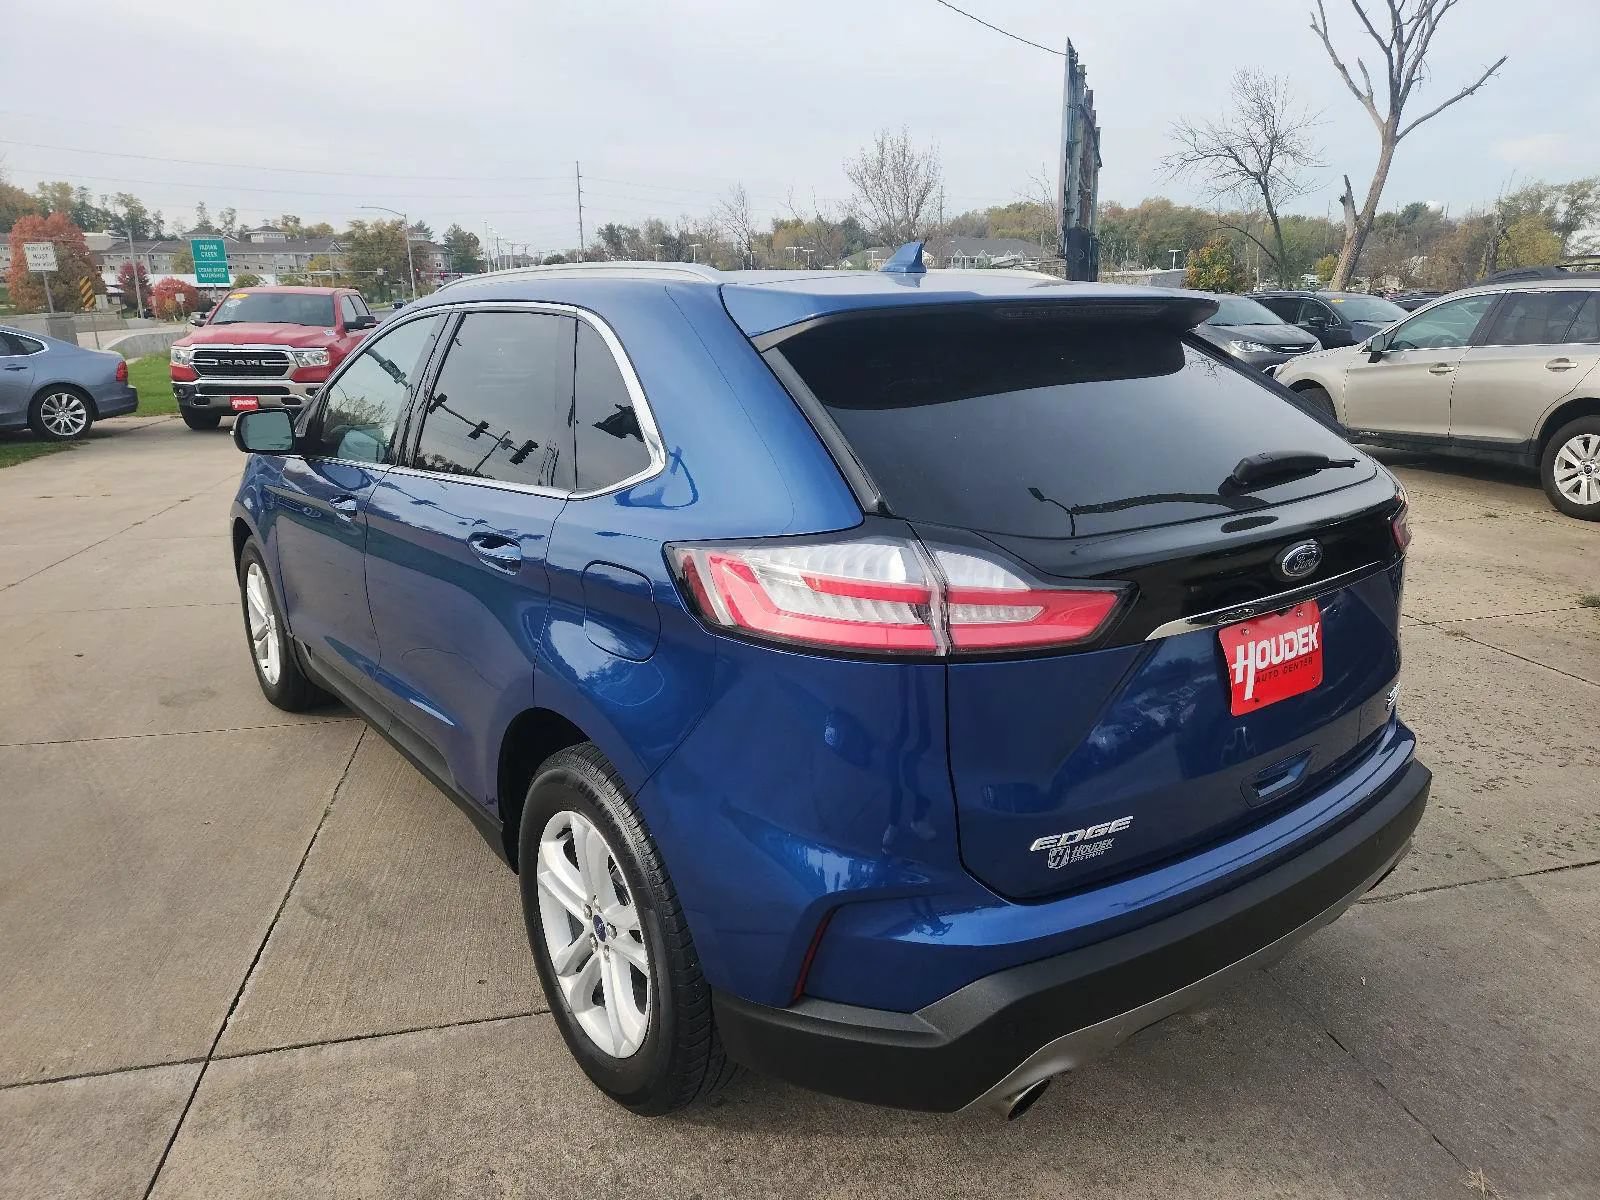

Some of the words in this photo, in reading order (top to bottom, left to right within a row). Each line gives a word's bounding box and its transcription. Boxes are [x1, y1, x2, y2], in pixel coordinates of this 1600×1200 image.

[219, 359, 260, 367] RAM
[1231, 621, 1320, 701] HOUDEK
[1255, 669, 1279, 684] AUTO
[1282, 656, 1313, 674] CENTER
[1029, 815, 1134, 852] EDGE
[1070, 837, 1115, 859] HOUDEK
